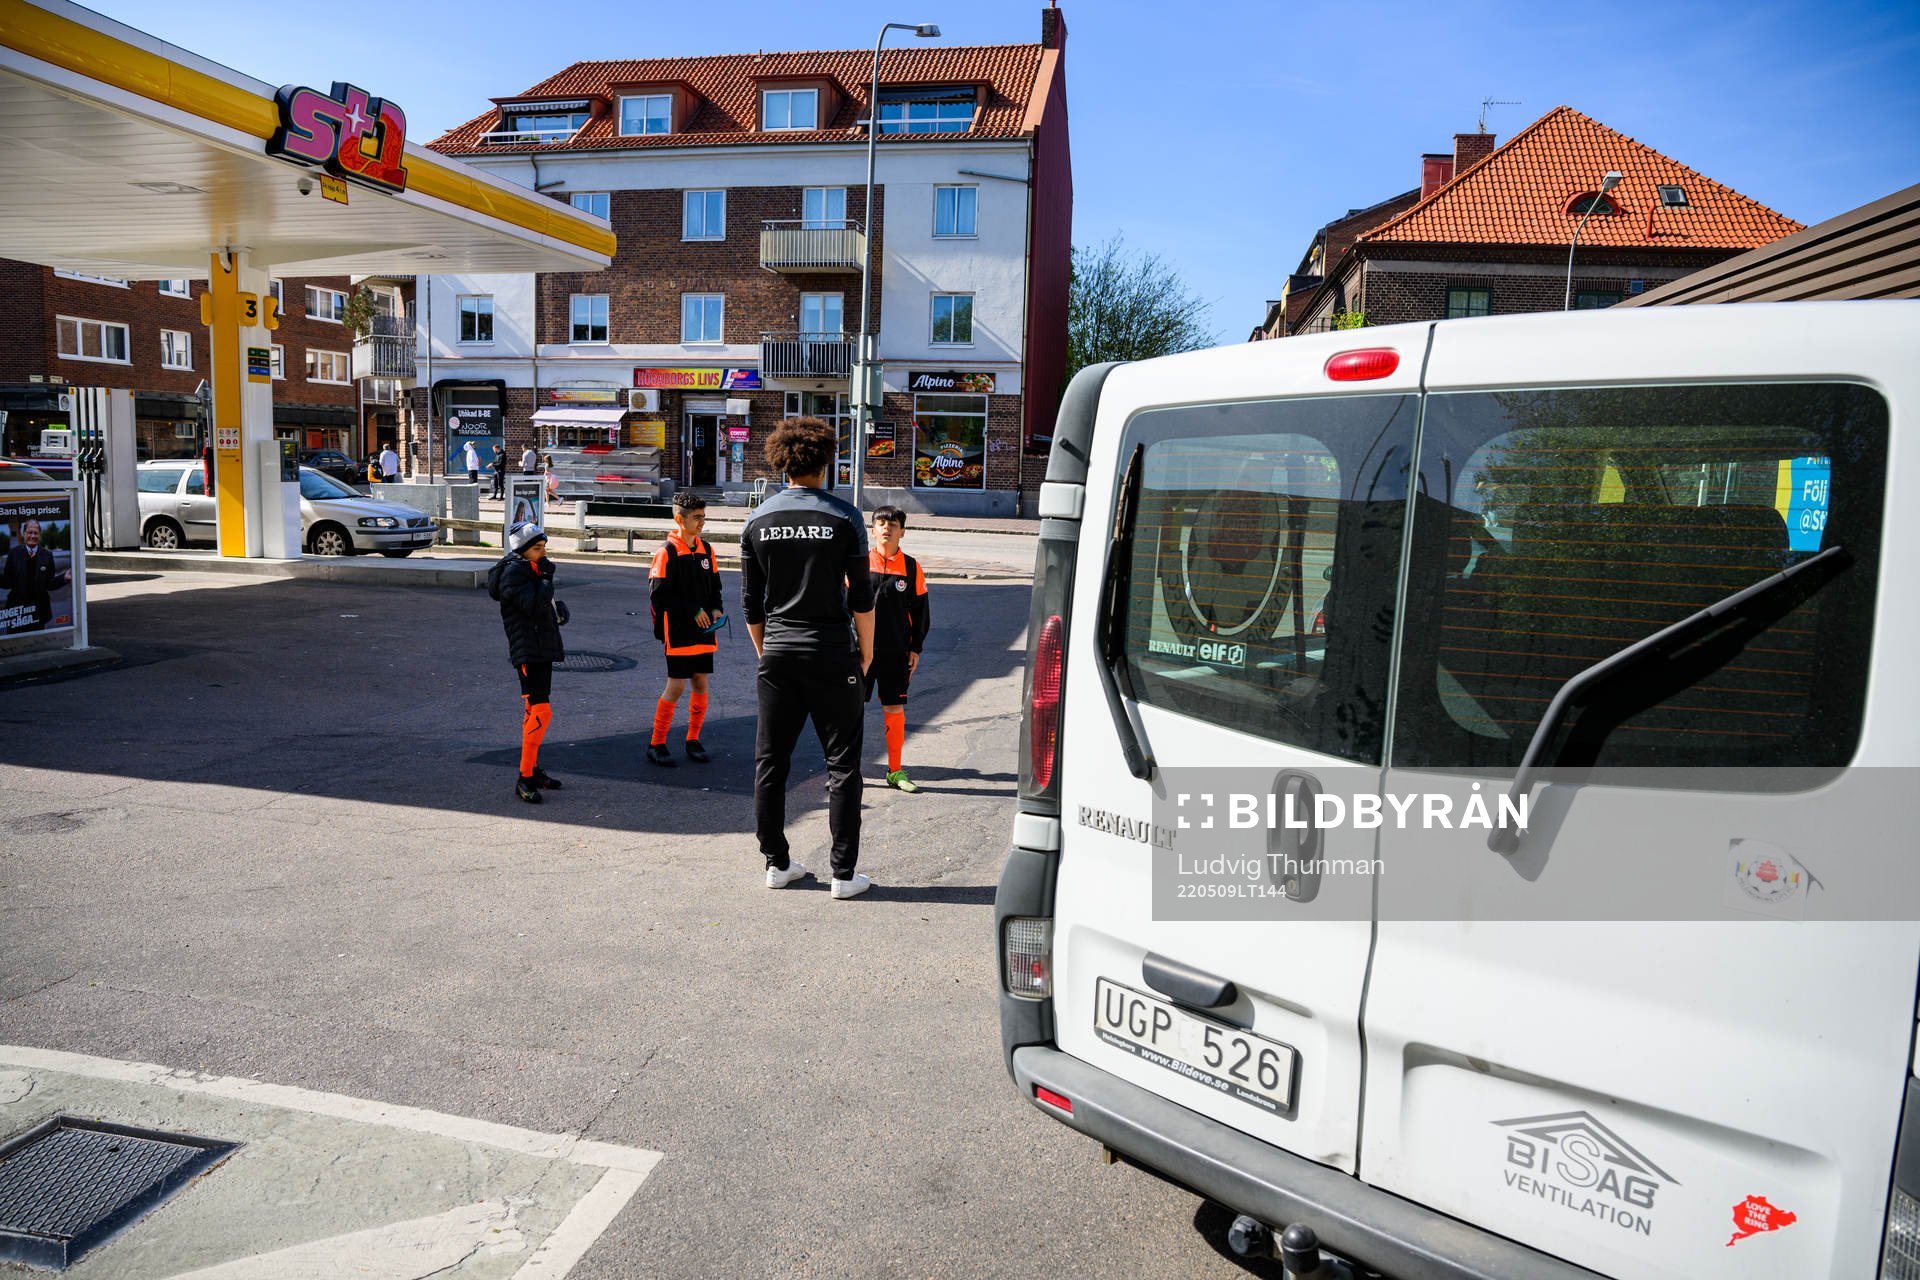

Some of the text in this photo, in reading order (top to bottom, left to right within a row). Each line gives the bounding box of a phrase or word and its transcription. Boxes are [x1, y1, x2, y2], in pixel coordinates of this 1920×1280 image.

[245, 300, 256, 318] 3
[637, 369, 695, 386] HÖGABORGS
[698, 372, 720, 386] LIVS
[912, 374, 954, 389] Alpino
[940, 443, 963, 454] PIZZERIA
[930, 455, 964, 469] Alpino
[1803, 480, 1828, 506] Följ
[19, 506, 36, 516] låga
[1800, 508, 1828, 534] @St
[759, 525, 834, 542] LEDARE
[1148, 639, 1228, 661] RENAULT elf
[1077, 804, 1177, 851] RENAULT
[1105, 987, 1279, 1091] UGP 526
[1102, 1032, 1277, 1110] Helsingborg www.Bildeve.se Landskrona
[1504, 1169, 1652, 1236] VENTILATION
[1745, 1200, 1771, 1216] LOVE
[1744, 1215, 1769, 1231] RING
[1748, 1210, 1768, 1223] THE
